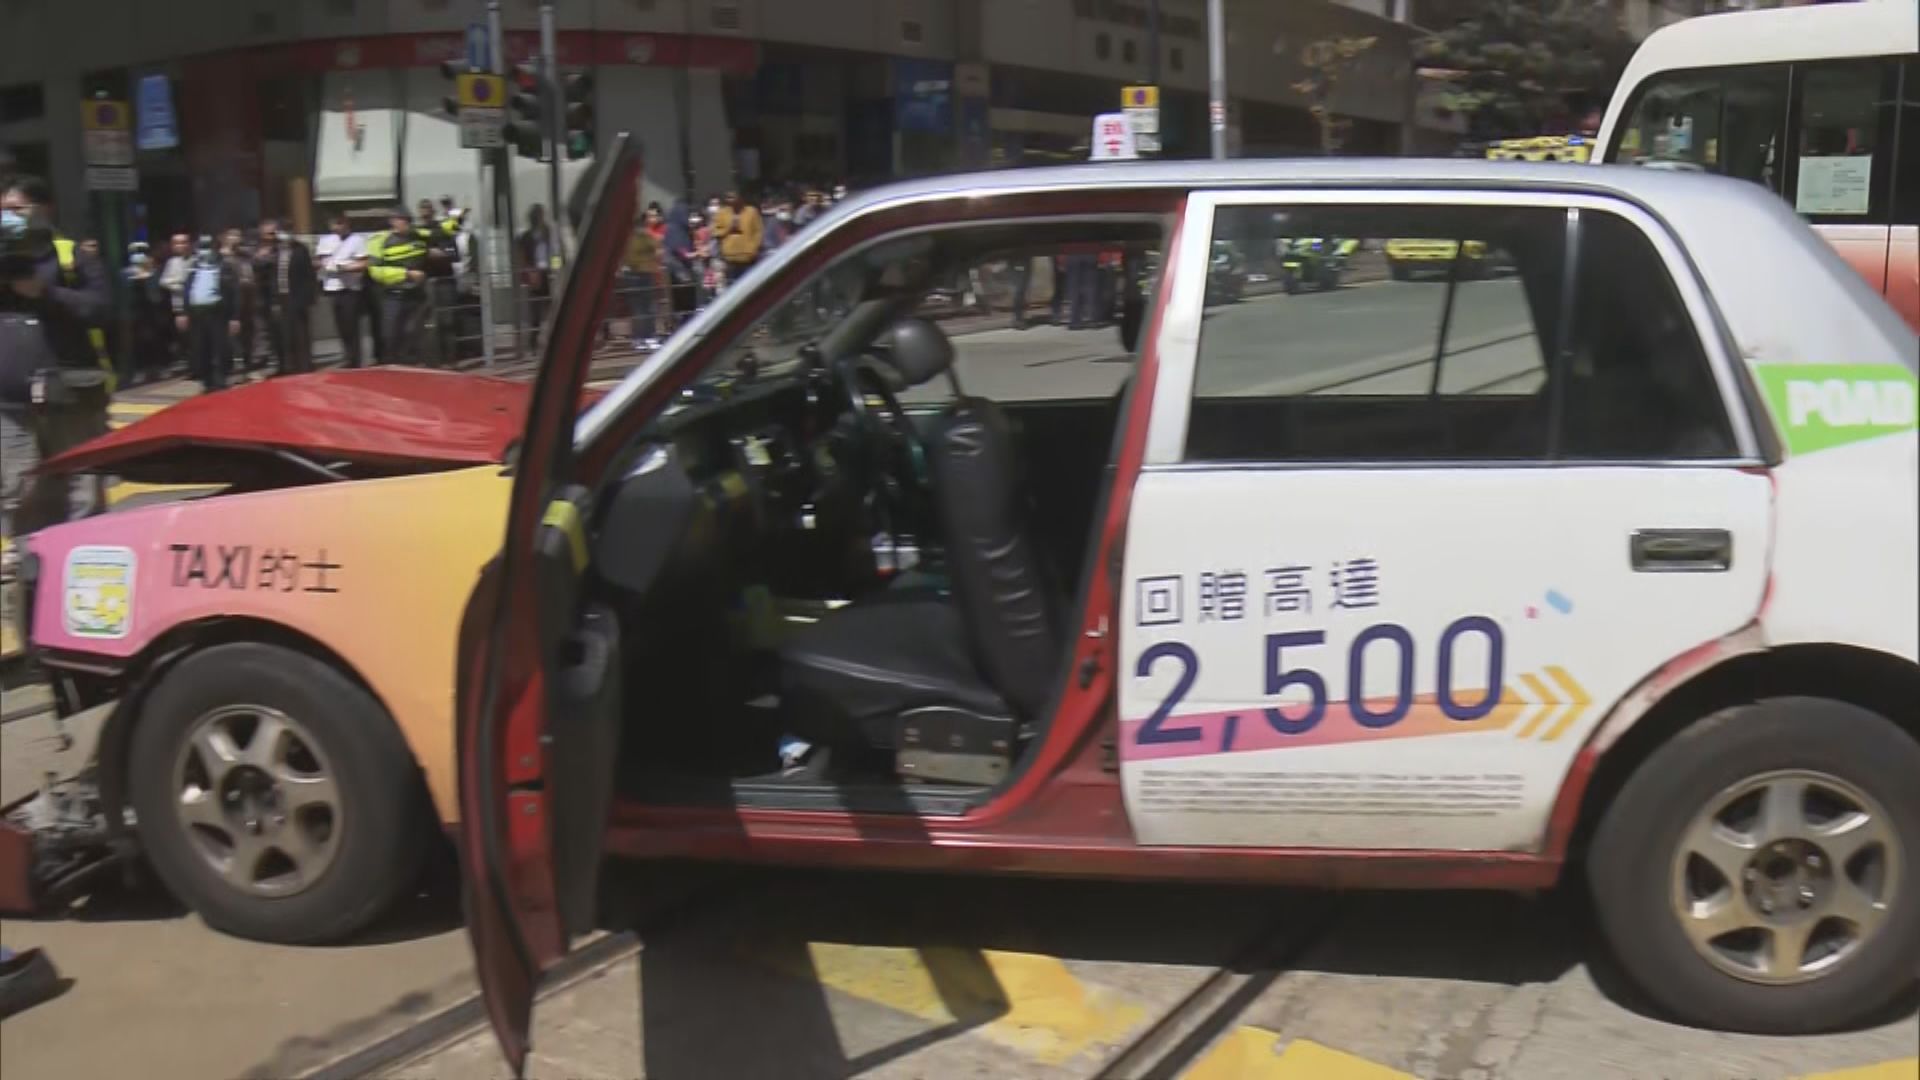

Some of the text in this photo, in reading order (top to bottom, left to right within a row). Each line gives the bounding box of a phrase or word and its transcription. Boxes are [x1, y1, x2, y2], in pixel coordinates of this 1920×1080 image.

[168, 544, 251, 589] TAXI
[258, 548, 342, 592] 的士
[1135, 558, 1380, 627] 回贈高達
[1135, 615, 1506, 754] 2,500
